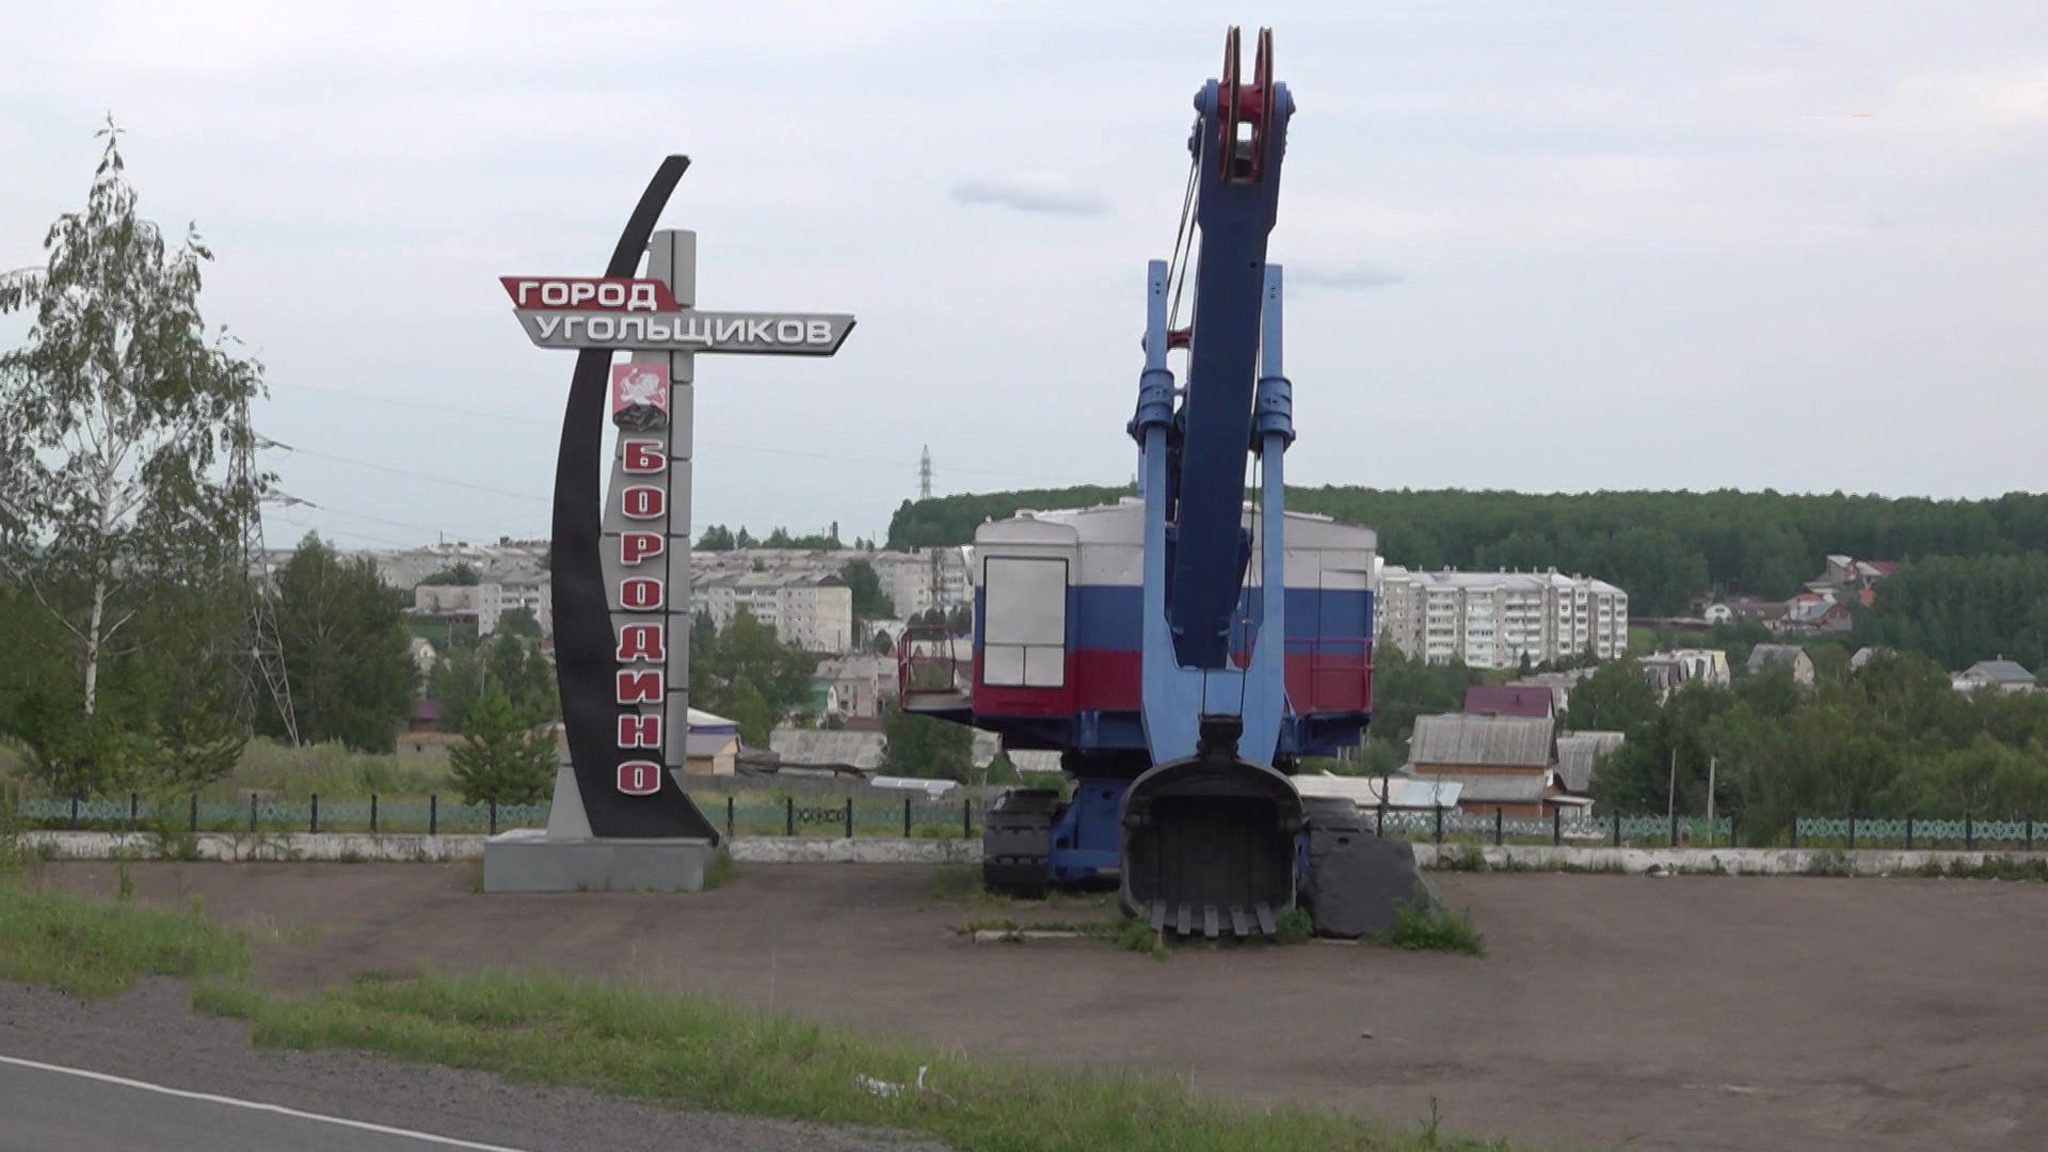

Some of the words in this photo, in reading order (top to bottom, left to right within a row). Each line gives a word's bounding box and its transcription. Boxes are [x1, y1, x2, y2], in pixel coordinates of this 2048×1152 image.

[518, 281, 657, 311] ГОРОД
[535, 315, 832, 346] УГОЛЬЩИКОВ
[616, 439, 666, 795] БОРОДИНО
